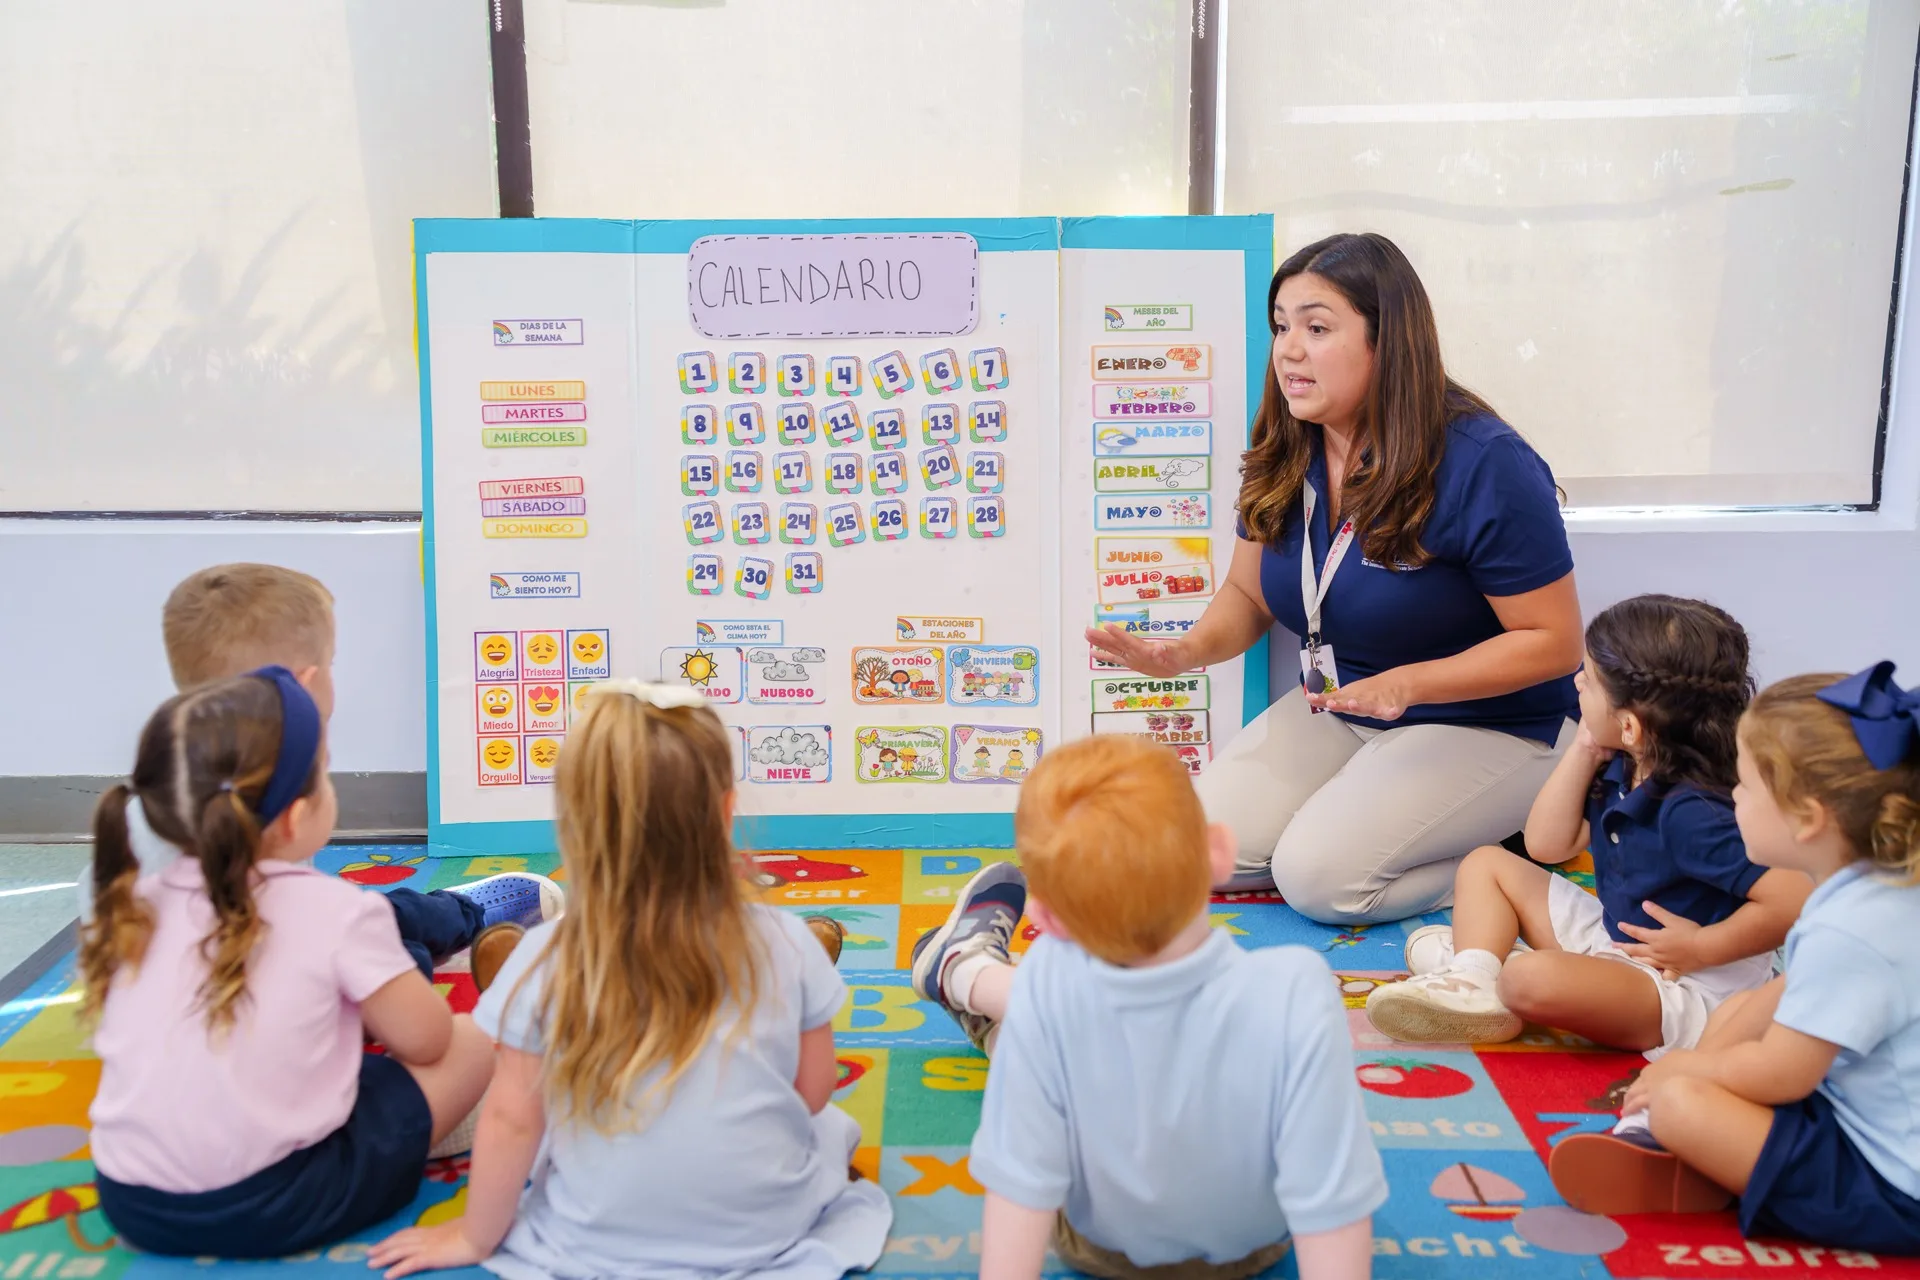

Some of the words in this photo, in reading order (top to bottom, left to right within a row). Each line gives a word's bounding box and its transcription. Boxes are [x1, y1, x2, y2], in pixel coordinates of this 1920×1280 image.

[699, 259, 921, 308] CALENDARIO
[1133, 307, 1162, 316] MESES
[1163, 307, 1179, 315] DEL
[520, 322, 541, 330] DIAS
[543, 322, 554, 330] DE
[555, 322, 567, 330] LA
[1146, 317, 1166, 327] AÑO
[525, 334, 563, 342] SEMANA
[691, 363, 706, 381] 1
[741, 363, 754, 381] 2
[934, 361, 949, 379] 6
[983, 359, 994, 377] 7
[1097, 357, 1167, 371] ENERO
[790, 365, 803, 383] 3
[837, 366, 852, 385] 4
[883, 364, 899, 383] 5
[510, 385, 556, 397] LUNES
[505, 408, 564, 419] MARTES
[1109, 401, 1196, 414] FEBRERO
[694, 414, 707, 433] 8
[739, 412, 753, 431] 9
[784, 414, 809, 431] 10
[830, 412, 855, 433] 11
[930, 414, 953, 431] 13
[976, 411, 1000, 428] 14
[494, 430, 576, 443] MIÉRCOLES
[876, 420, 900, 437] 12
[1135, 425, 1205, 438] MARZO
[689, 466, 712, 482] 15
[732, 462, 756, 478] 16
[782, 462, 803, 479] 17
[833, 464, 856, 480] 18
[876, 460, 900, 478] 19
[927, 456, 950, 476] 20
[974, 460, 997, 476] 21
[1098, 465, 1160, 479] ABRIL
[501, 481, 562, 495] VIERNES
[502, 500, 565, 513] SÁBADO
[975, 506, 998, 523] 28
[1107, 506, 1162, 520] MAYO
[692, 511, 715, 530] 22
[741, 513, 763, 530] 23
[787, 513, 811, 530] 24
[878, 510, 902, 527] 26
[928, 507, 950, 523] 27
[496, 523, 574, 534] DOMINGO
[834, 514, 856, 533] 25
[1106, 551, 1163, 563] JUNIO
[522, 575, 551, 583] COMO
[553, 574, 567, 582] ME
[694, 564, 717, 580] 29
[743, 567, 767, 586] 30
[793, 563, 816, 580] 31
[1102, 570, 1162, 587] JULIO
[515, 586, 546, 594] SIENTO
[548, 585, 571, 594] HOY?
[922, 619, 975, 628] ESTACIONES
[1125, 619, 1198, 633] AGOST
[930, 631, 945, 639] DEL
[946, 631, 966, 639] AÑO
[892, 655, 932, 666] OTOÑO
[973, 656, 1024, 666] INVIERNO
[525, 668, 562, 677] Tristeza
[571, 666, 607, 676] Enfado
[760, 688, 814, 698] NUBOSO
[1105, 679, 1199, 695] OCTUBRE
[483, 720, 514, 730] Miedo
[531, 719, 558, 729] Amor
[880, 738, 940, 748] PRIMAVERA
[977, 737, 1021, 747] VERANO
[481, 773, 519, 784] Orgullo
[767, 768, 811, 779] NIEVE
[921, 856, 982, 876] D
[784, 889, 868, 899] car
[831, 985, 926, 1033] B
[1372, 1232, 1536, 1259] acht
[1657, 1239, 1882, 1269] zebra
